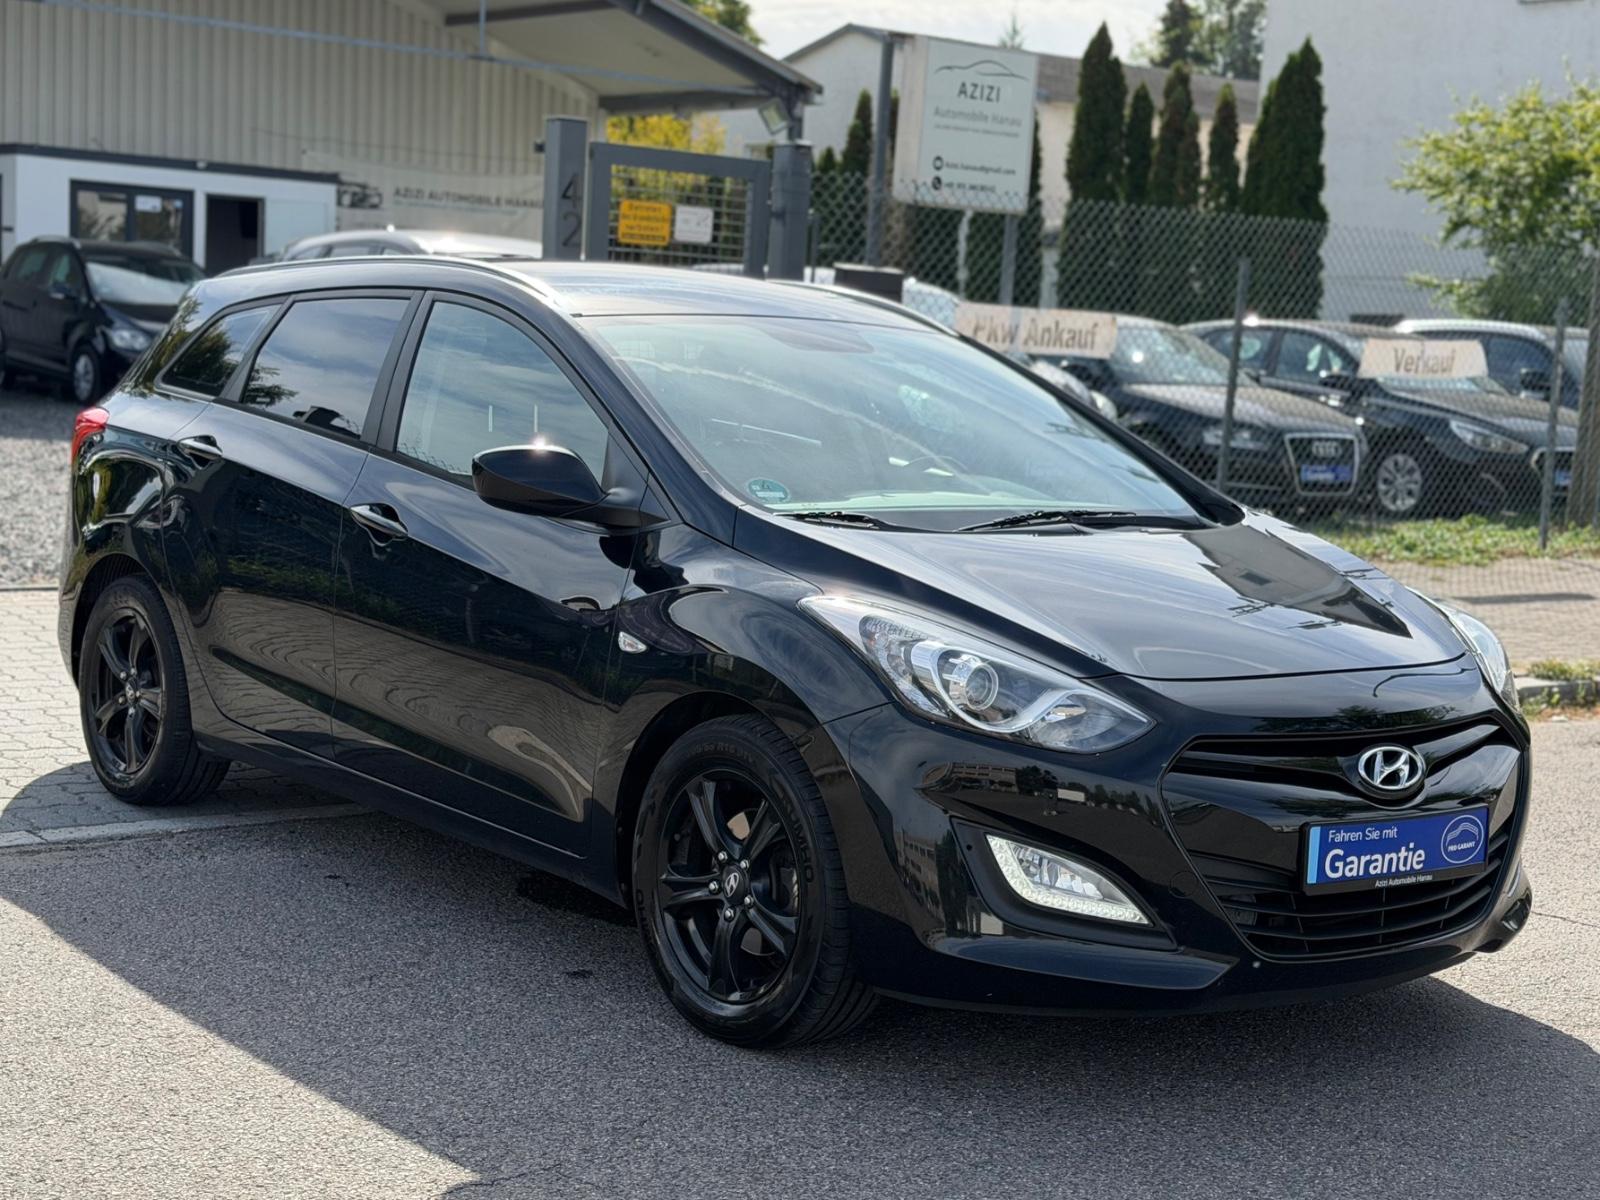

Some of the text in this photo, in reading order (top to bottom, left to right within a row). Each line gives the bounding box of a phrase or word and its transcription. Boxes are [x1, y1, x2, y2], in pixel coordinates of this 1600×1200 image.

[957, 82, 1001, 103] AZIZI
[1023, 318, 1099, 350] Ankauf
[1328, 826, 1398, 843] Fahren Sie mit
[1325, 842, 1425, 878] Garantie
